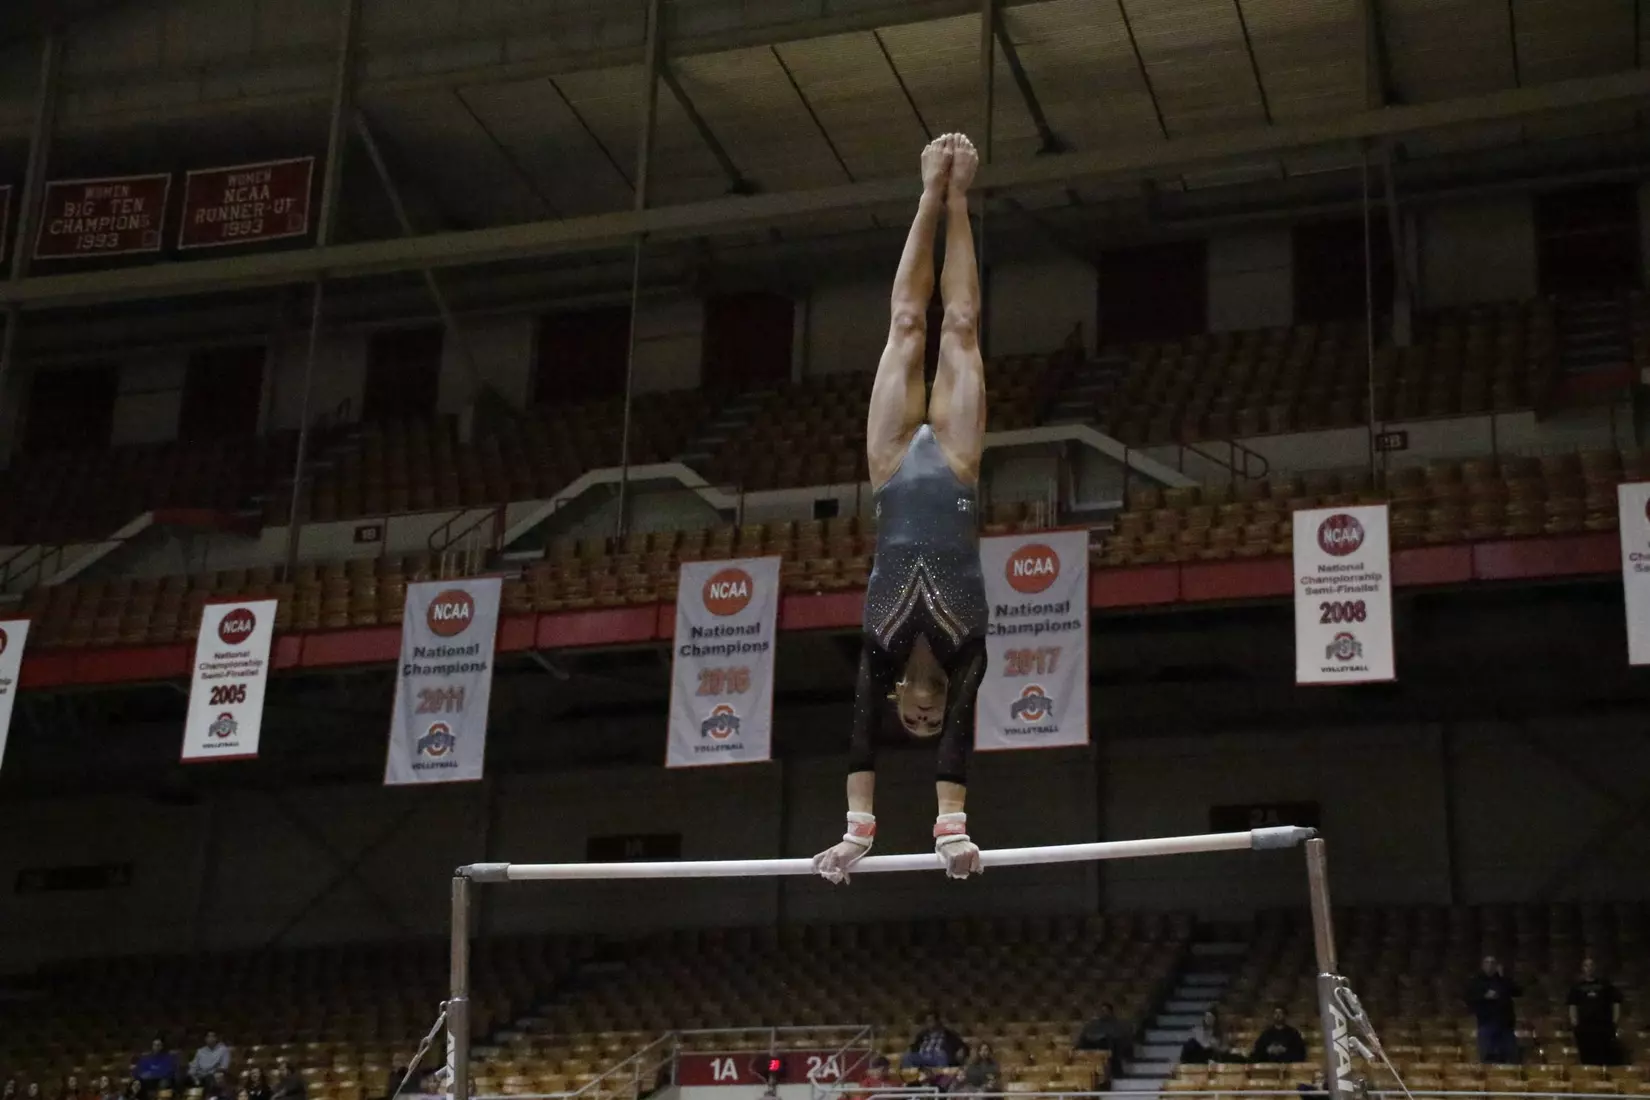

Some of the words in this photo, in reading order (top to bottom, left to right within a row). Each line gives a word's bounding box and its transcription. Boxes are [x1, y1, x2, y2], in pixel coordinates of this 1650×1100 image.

[223, 184, 270, 204] NCAA
[63, 200, 96, 218] BIG
[111, 197, 145, 214] TEN
[50, 214, 151, 235] CHAMPIONS
[221, 218, 264, 238] 1993
[75, 232, 120, 250] 1993
[1324, 527, 1361, 544] NCAA
[1013, 557, 1054, 577] NCAA
[1317, 562, 1364, 574] National
[1300, 571, 1383, 586] Championship
[710, 580, 749, 600] NCAA
[1305, 583, 1379, 596] Semi-Finalist
[432, 602, 470, 621] NCAA
[995, 600, 1071, 618] National
[1319, 600, 1367, 625] 2008
[222, 618, 253, 635] NCAA
[691, 622, 761, 639] National
[213, 650, 251, 660] National
[412, 643, 480, 659] National
[679, 640, 770, 658] Champions
[403, 659, 487, 678] Champions
[1003, 646, 1063, 677] 2017
[208, 684, 248, 706] 2005
[414, 684, 466, 715] 2011
[709, 1056, 739, 1081] 1A
[806, 1055, 842, 1079] 2A
